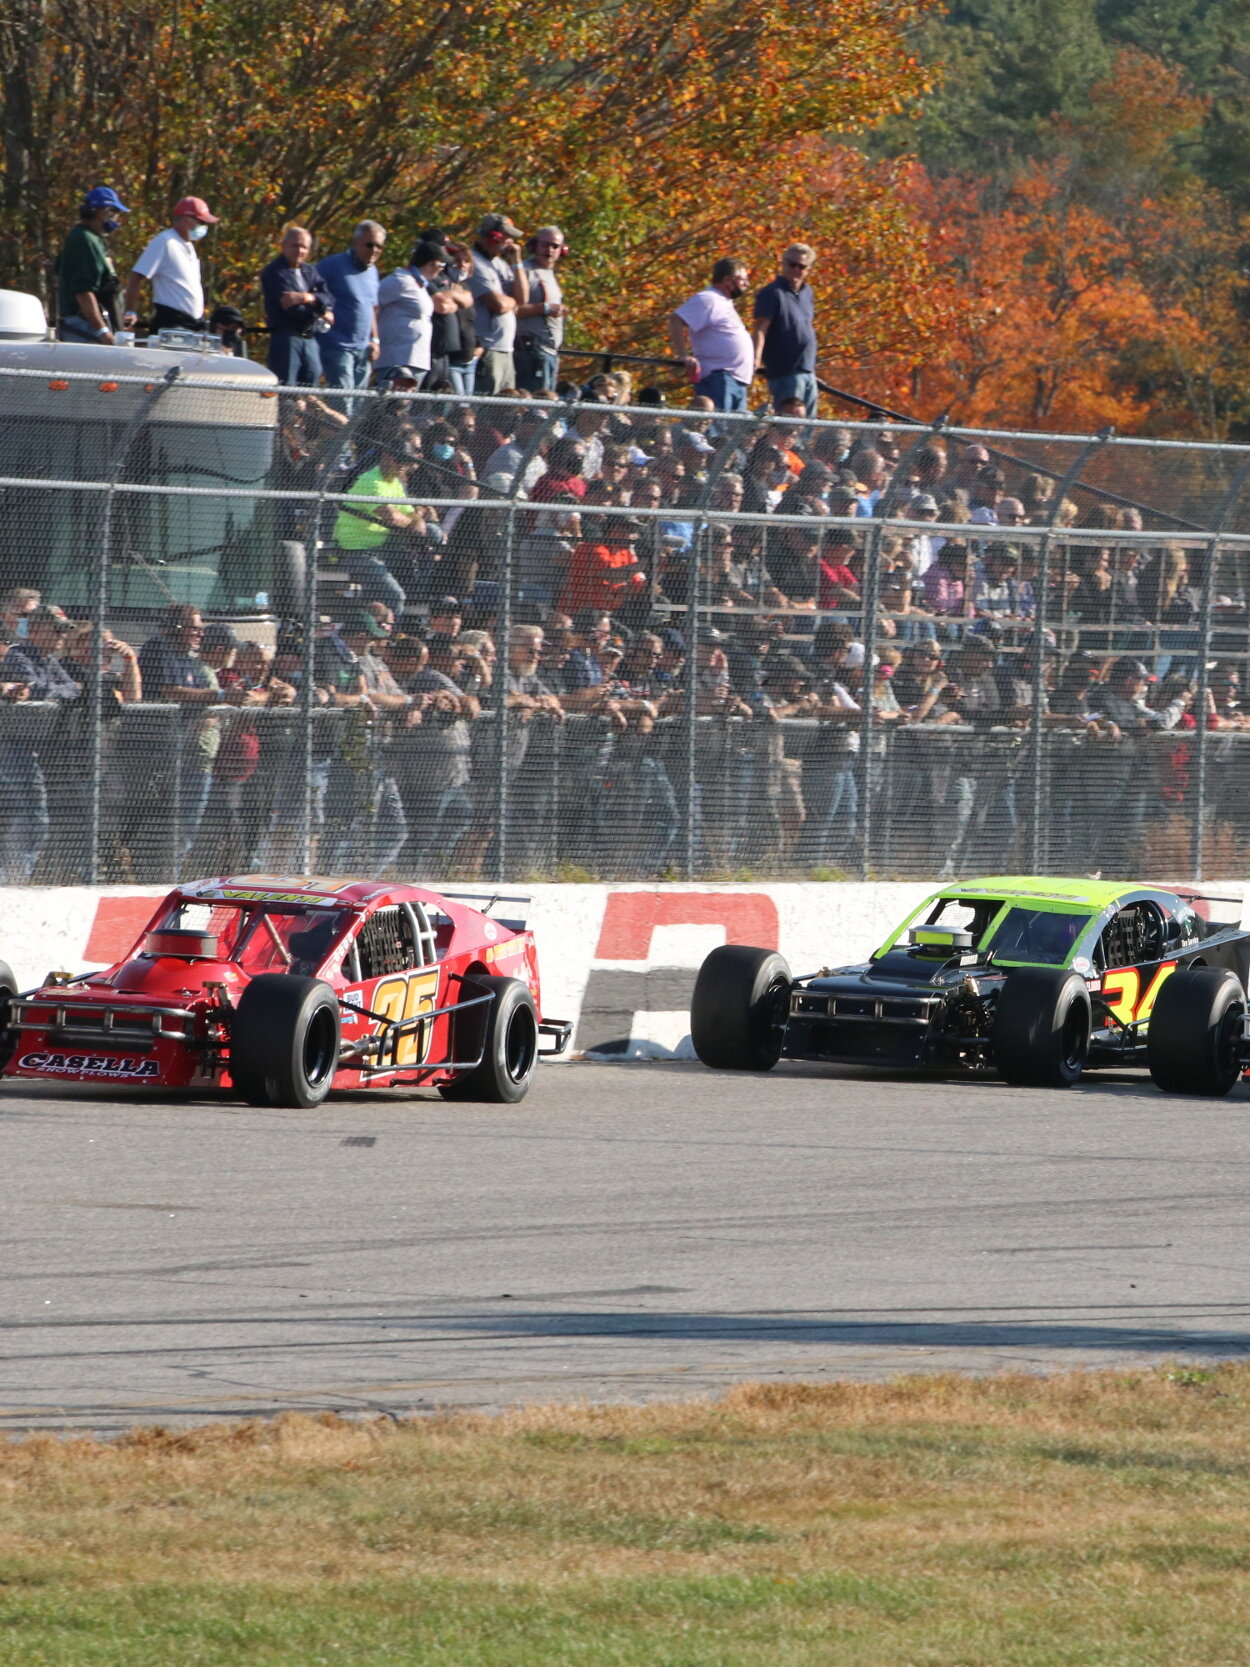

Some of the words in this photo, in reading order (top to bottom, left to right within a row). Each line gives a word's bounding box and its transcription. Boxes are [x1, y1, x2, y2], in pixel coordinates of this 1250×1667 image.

[222, 889, 326, 904] VALENTI
[360, 964, 441, 1082] 25
[18, 1052, 160, 1077] CASELLA
[36, 1066, 131, 1078] SNOWPLOWS
